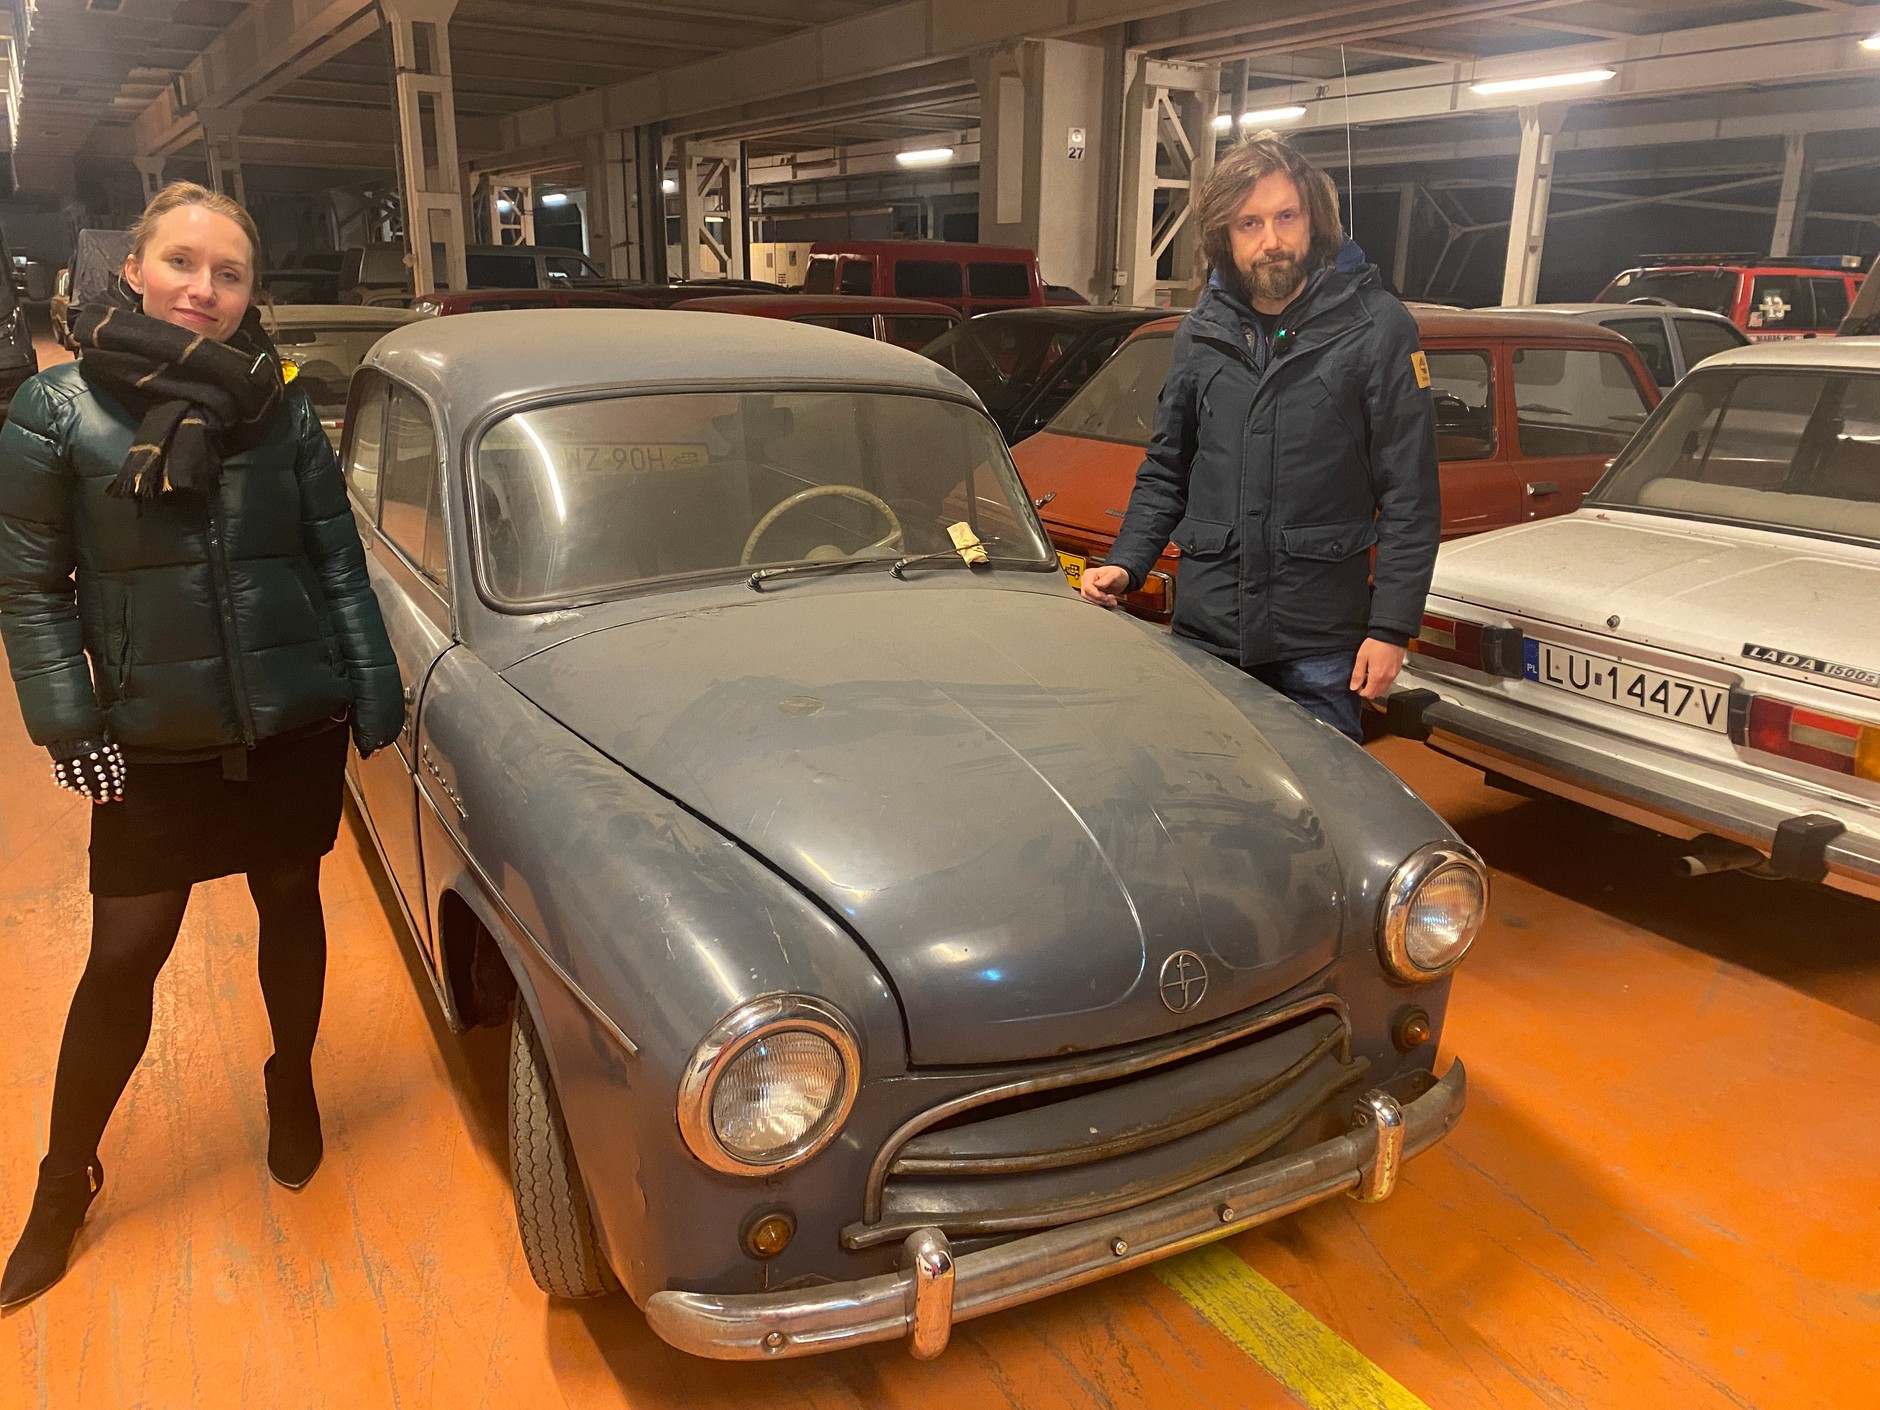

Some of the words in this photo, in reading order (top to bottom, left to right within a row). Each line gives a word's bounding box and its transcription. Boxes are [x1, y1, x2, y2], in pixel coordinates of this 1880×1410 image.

[1068, 146, 1085, 160] 27
[1526, 663, 1538, 674] PL
[1748, 647, 1816, 671] LADA
[1546, 648, 1591, 690] LU
[1607, 666, 1723, 725] 1447V
